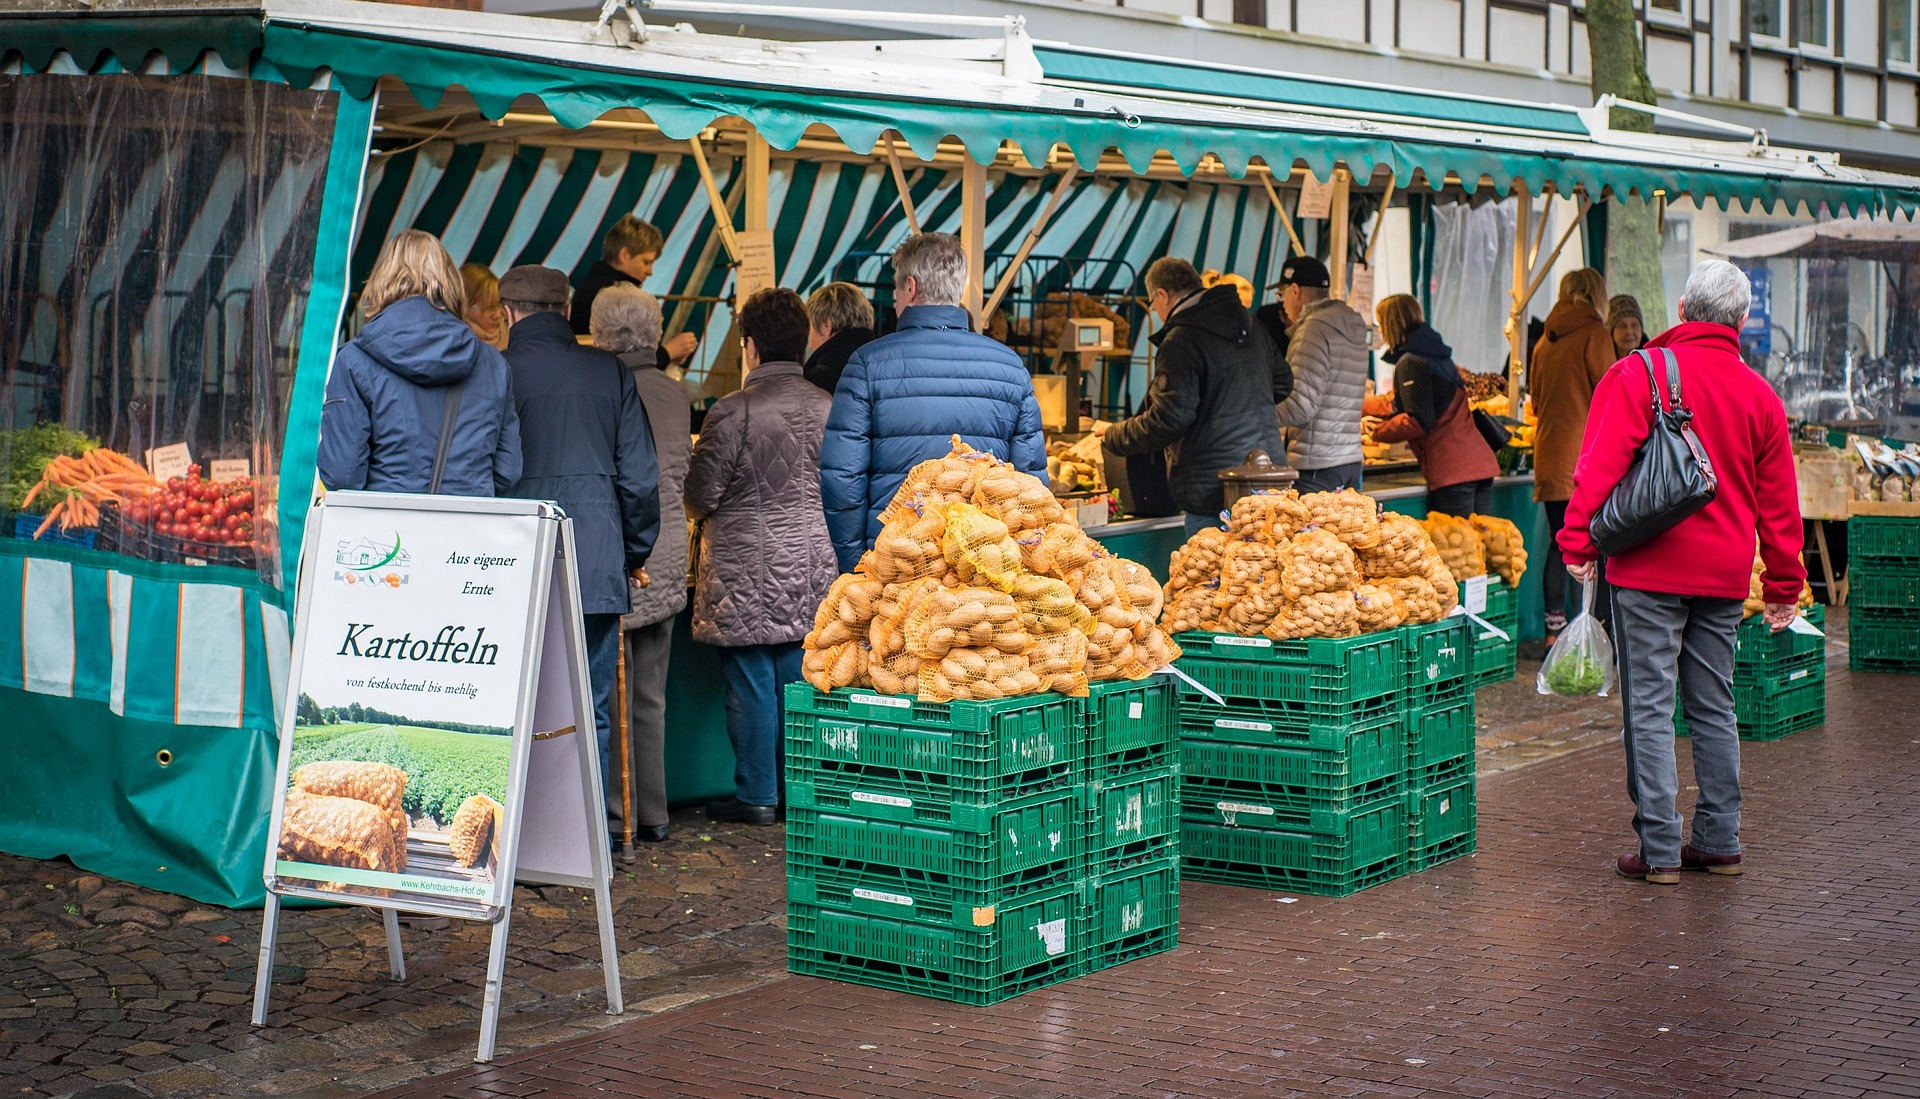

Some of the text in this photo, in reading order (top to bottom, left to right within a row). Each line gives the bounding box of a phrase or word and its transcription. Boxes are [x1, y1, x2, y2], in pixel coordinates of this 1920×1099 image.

[445, 551, 517, 570] Aus eigener
[461, 581, 494, 596] Ernte
[336, 622, 499, 666] Kartoffeln
[346, 676, 479, 700] von festkochend bis mehlig
[400, 879, 486, 897] www.Kehrbachs-Hof.de
